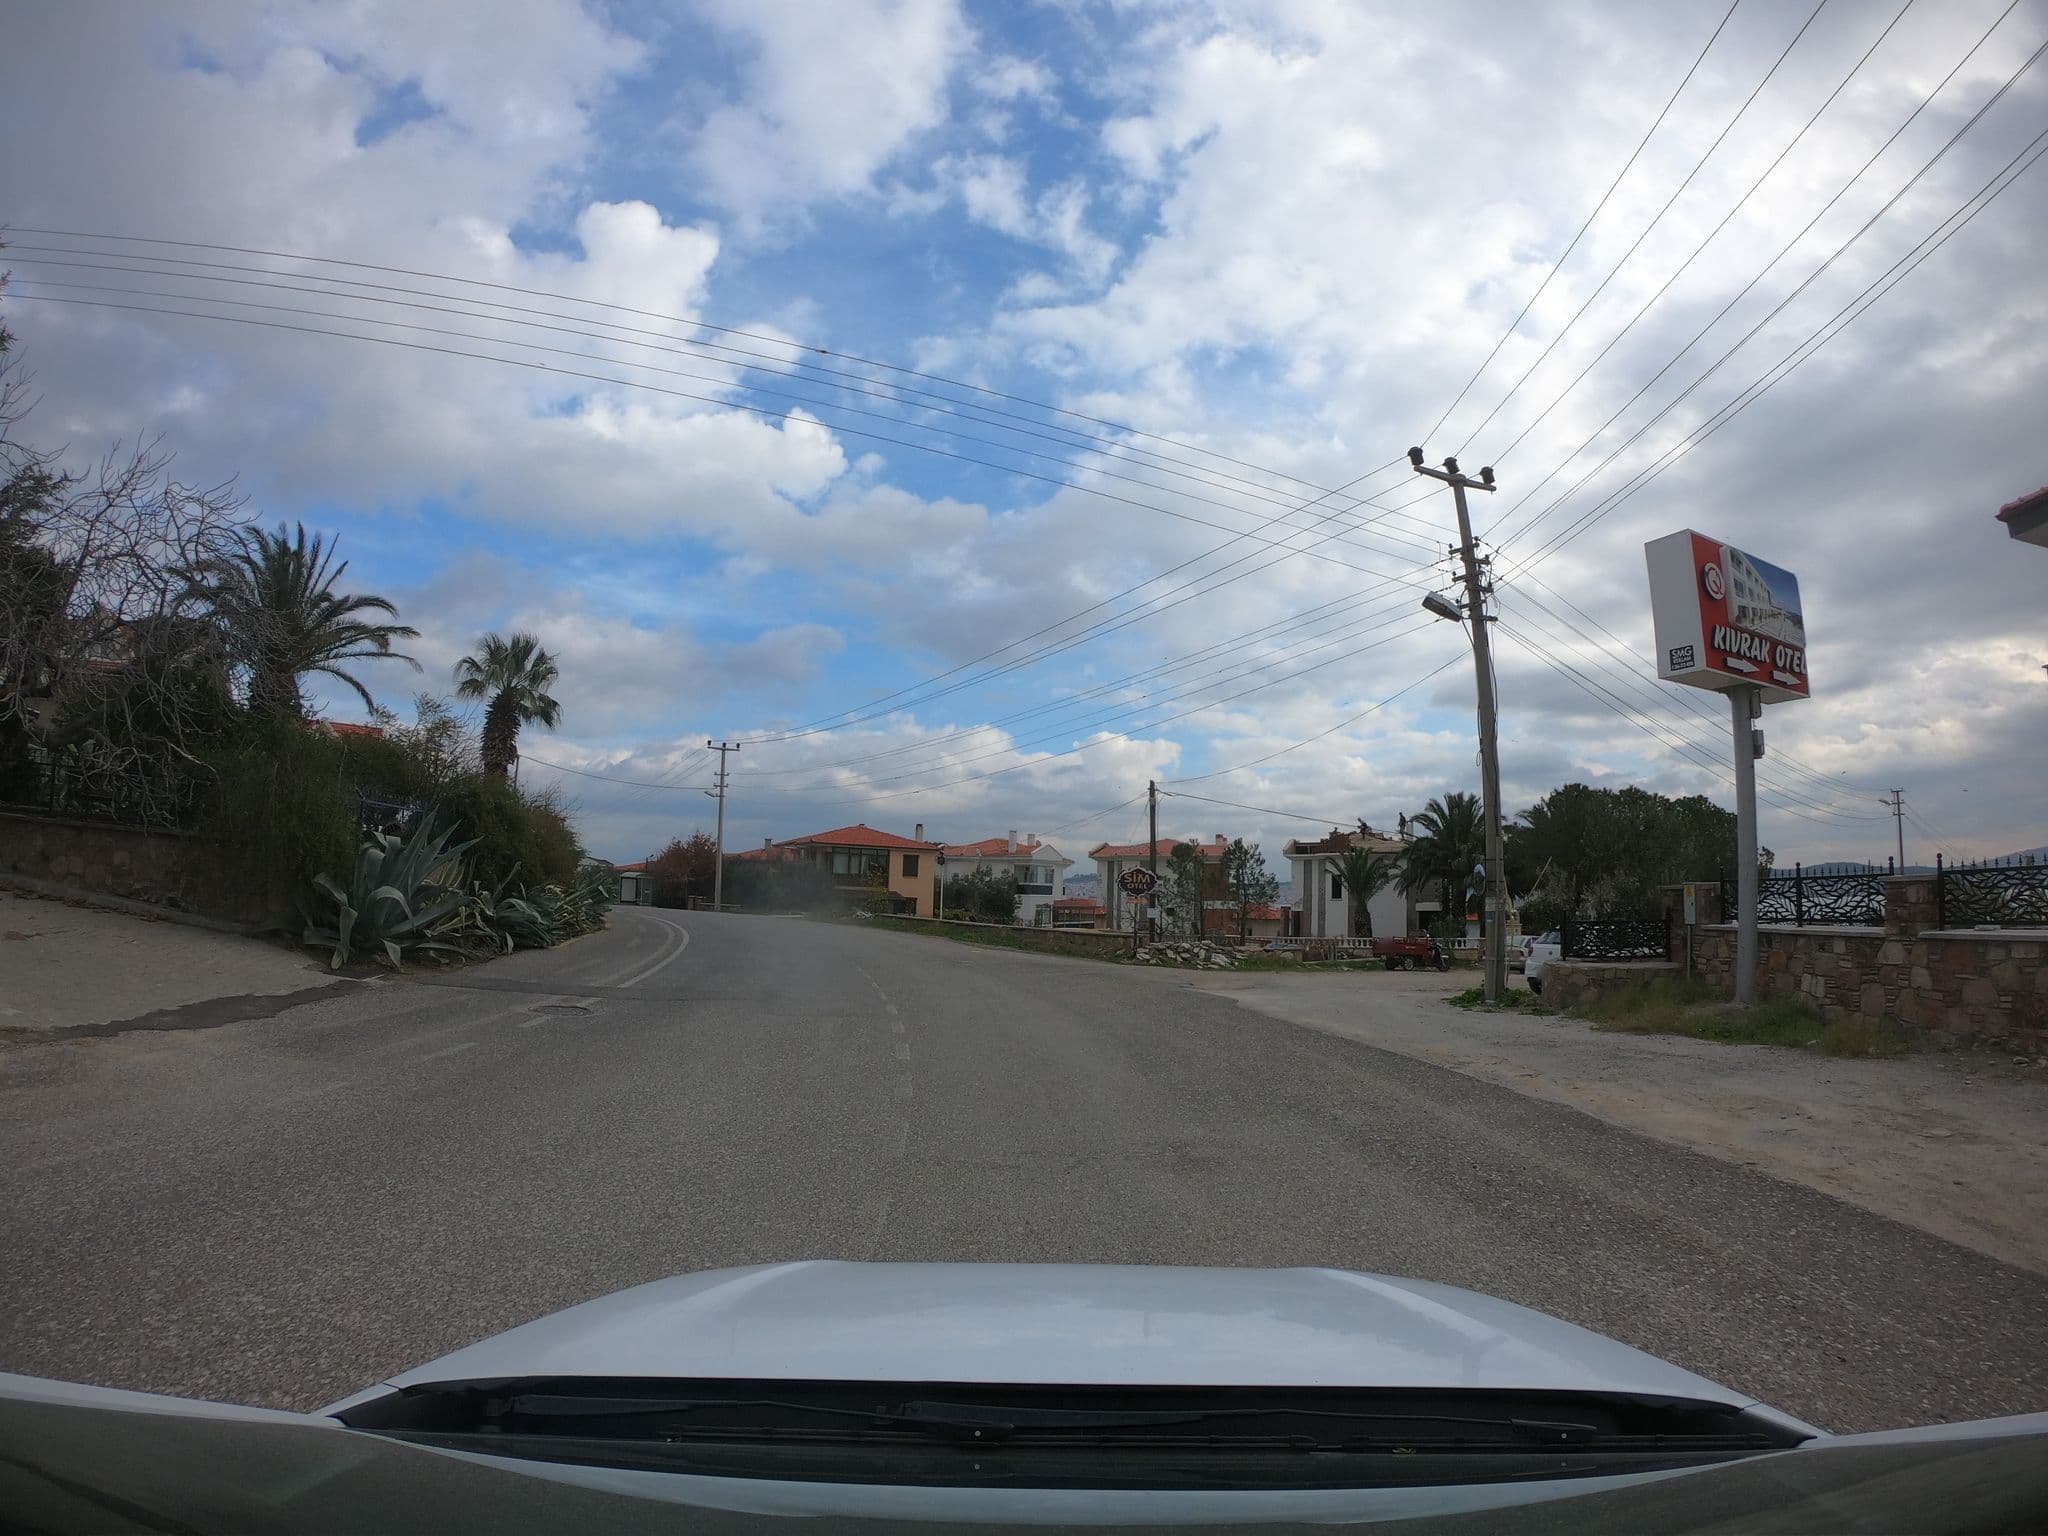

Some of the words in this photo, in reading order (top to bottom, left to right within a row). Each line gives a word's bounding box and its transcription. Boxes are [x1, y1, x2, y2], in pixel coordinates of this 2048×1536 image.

[1671, 647, 1692, 658] SMG
[1714, 624, 1770, 663] KIVRAK
[1775, 645, 1808, 675] OTEL
